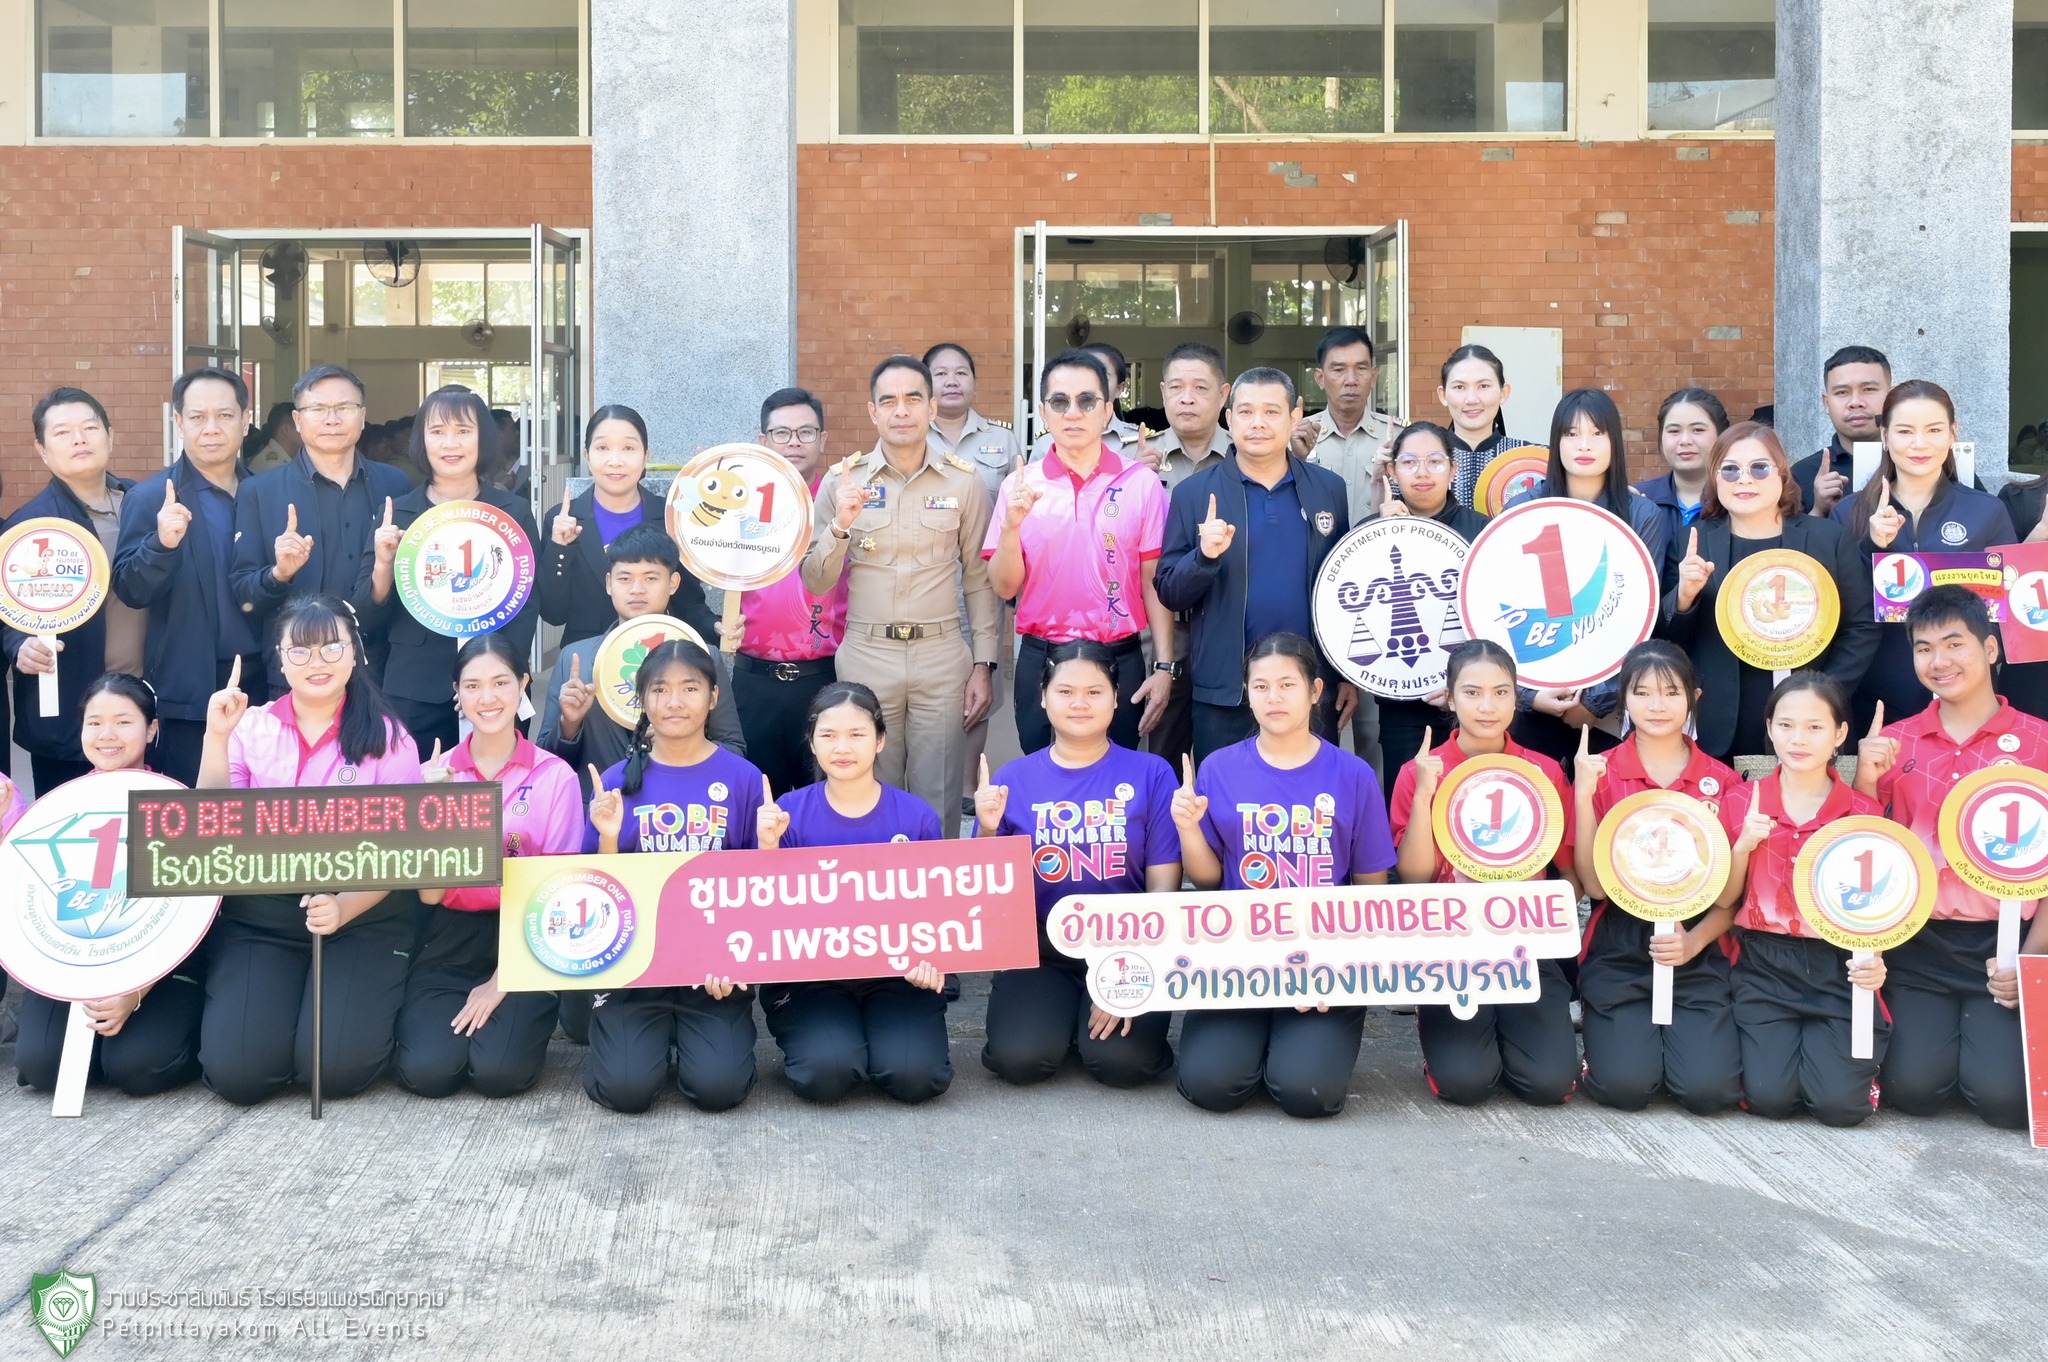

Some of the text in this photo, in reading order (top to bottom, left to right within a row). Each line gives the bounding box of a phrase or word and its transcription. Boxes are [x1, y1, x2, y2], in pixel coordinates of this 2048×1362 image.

[756, 482, 775, 523] 1
[407, 508, 522, 547] TO BE NUMBER ONE
[56, 564, 84, 575] ONE
[57, 549, 69, 557] TO
[459, 539, 472, 578] 1
[1326, 525, 1465, 583] DEPARTMENT OF PROBATIO
[1521, 523, 1574, 619] 1
[1892, 559, 1906, 587] 1
[2030, 578, 2048, 610] 1
[455, 619, 497, 633] อ.เมือง
[1494, 604, 1530, 630] TO
[1525, 621, 1562, 648] BE
[2032, 611, 2045, 620] BE
[1359, 669, 1448, 693] กรมคุมประพ
[138, 793, 494, 839] TO BE NUMBER ONE
[633, 802, 730, 838] TO BE
[1031, 798, 1127, 829] TO BE
[1236, 802, 1335, 838] TO BE
[1485, 788, 1504, 830] 1
[1999, 801, 2020, 845] 1
[89, 818, 123, 889] 1
[640, 834, 724, 852] NUMBER
[1035, 826, 1127, 845] NUMBER
[1243, 834, 1333, 854] NUMBER
[1477, 829, 1496, 842] BE
[1991, 843, 2011, 856] BE
[147, 841, 484, 886] โรงเรียนเพชรพิทยาคม
[1032, 842, 1128, 883] ONE
[1239, 851, 1335, 890] ONE
[1854, 849, 1873, 893] 1
[67, 890, 99, 911] BE
[607, 883, 626, 903] ONE
[688, 858, 1015, 925] ชุมชนบ้านนายม
[1847, 893, 1866, 906] BE
[88, 896, 173, 957] โรงเรียนเพชรพิทยา
[576, 898, 587, 928] 1
[1060, 894, 1569, 942] อำเภอ TO BE NUMBER ONE
[726, 905, 983, 970] จ.เพชรบูรณ์
[1130, 975, 1150, 983] ONE
[1164, 946, 1532, 1007] อำเภอเมืองเพชรบูรณ์
